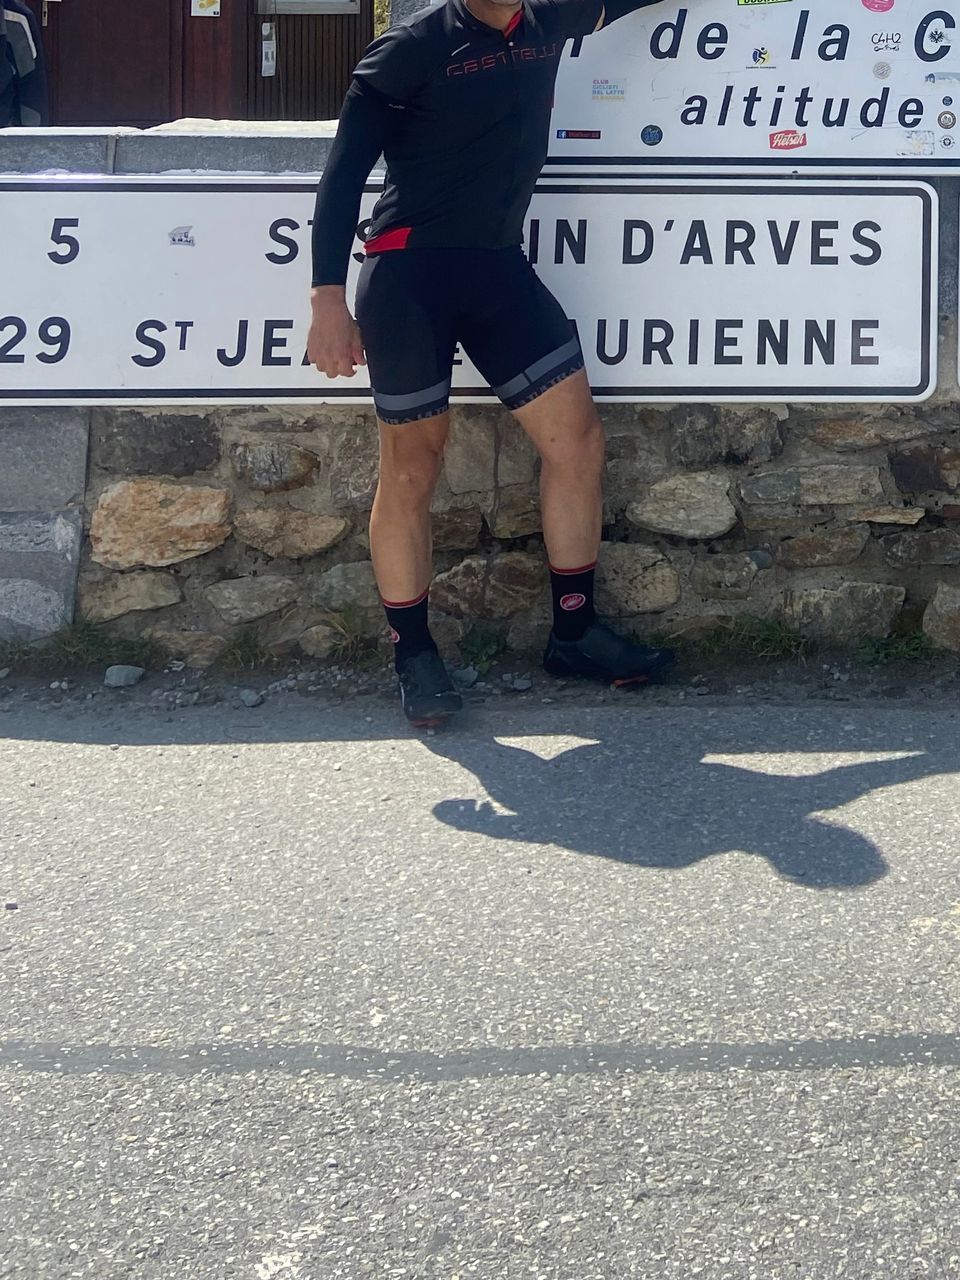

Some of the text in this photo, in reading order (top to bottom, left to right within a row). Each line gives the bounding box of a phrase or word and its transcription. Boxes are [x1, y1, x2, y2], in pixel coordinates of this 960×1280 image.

[650, 9, 728, 60] de
[791, 10, 850, 61] la
[681, 86, 923, 129] altitude
[47, 218, 80, 265] 5
[265, 218, 313, 265] S
[623, 220, 882, 266] D'ARVES
[0, 316, 879, 367] 29 ST JE URIENNE
